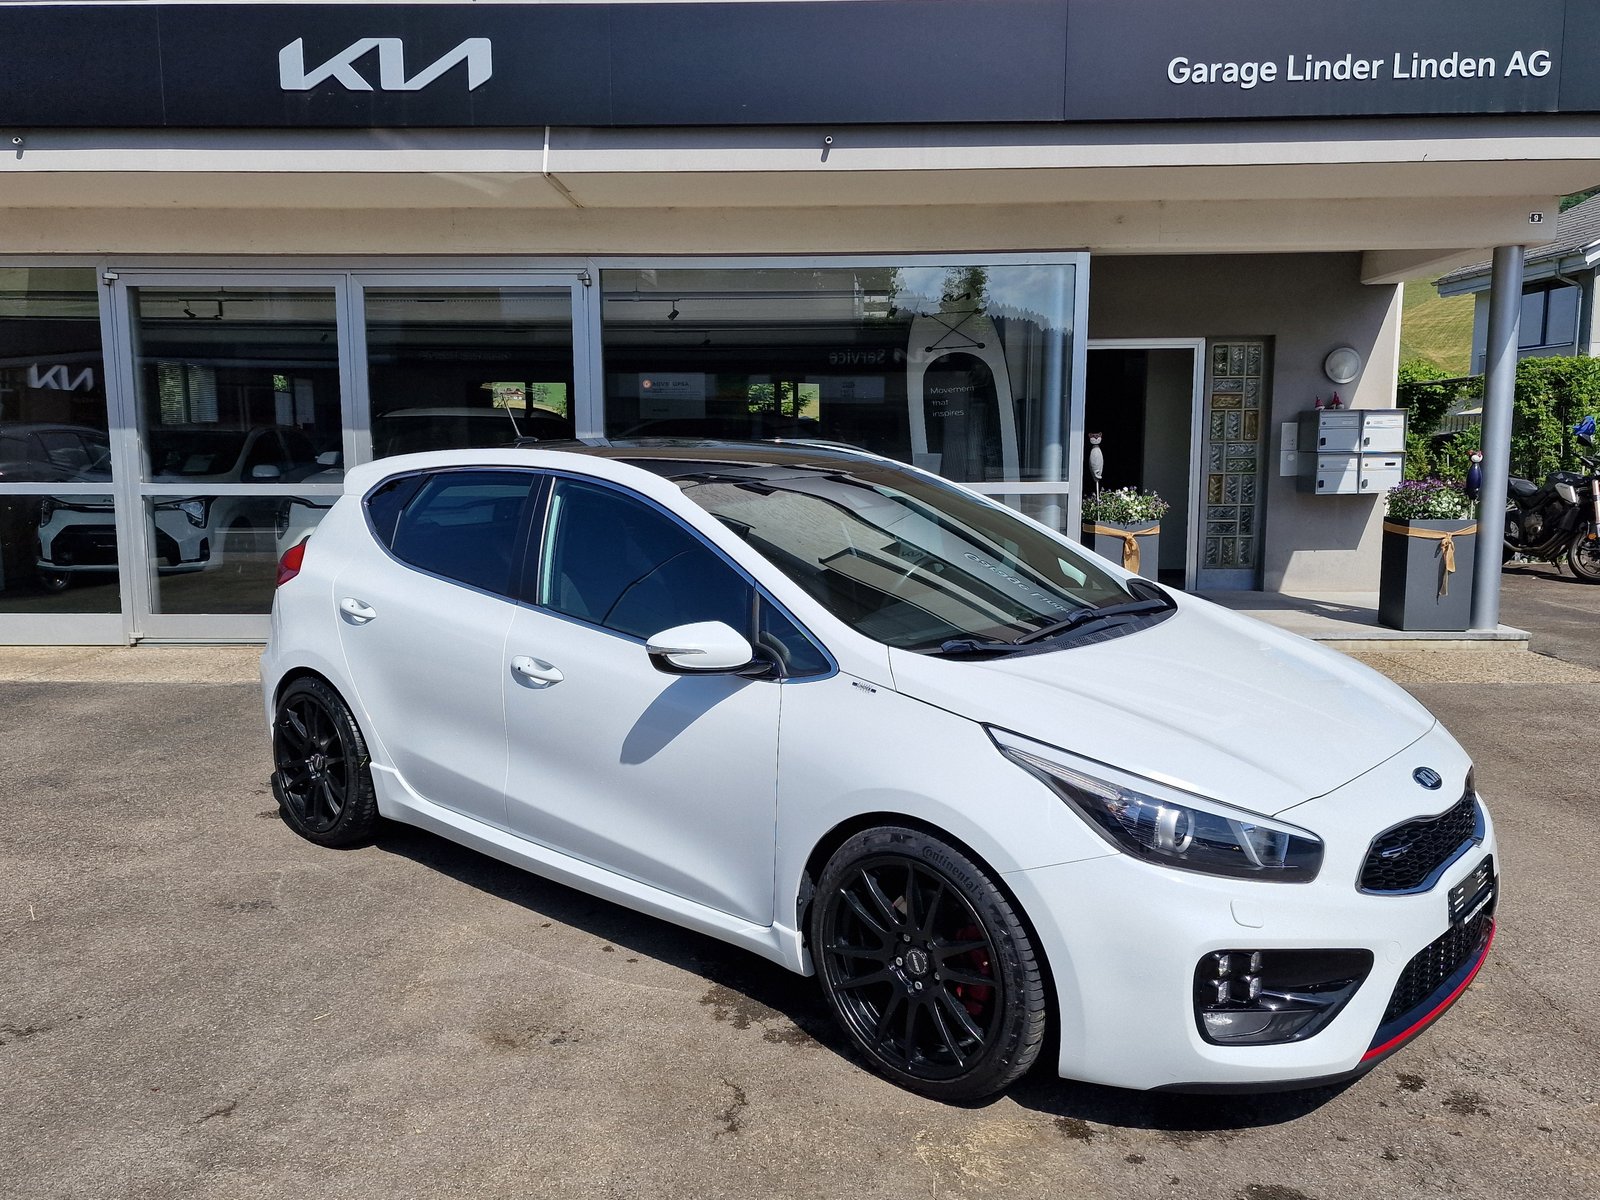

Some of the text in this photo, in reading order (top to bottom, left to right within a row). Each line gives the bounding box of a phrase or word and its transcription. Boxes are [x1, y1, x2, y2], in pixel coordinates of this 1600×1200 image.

[1166, 50, 1553, 89] Garage Linder Linden AG
[930, 385, 976, 395] Movement
[932, 409, 965, 417] inspires
[922, 845, 979, 893] Continental
